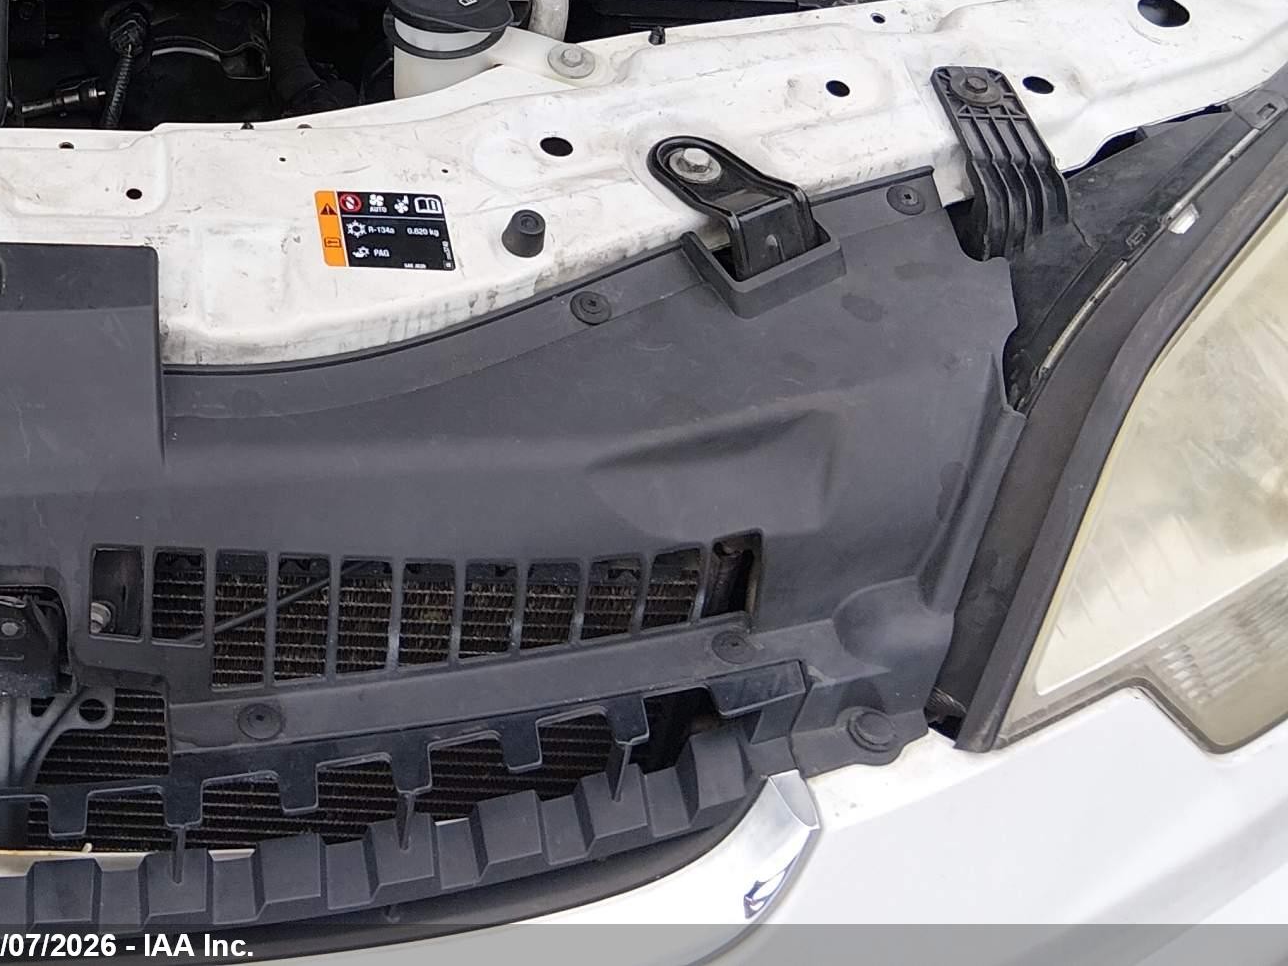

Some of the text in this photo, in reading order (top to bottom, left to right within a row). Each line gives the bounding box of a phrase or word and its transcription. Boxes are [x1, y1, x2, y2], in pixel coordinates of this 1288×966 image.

[368, 226, 395, 234] R-134a
[429, 228, 440, 237] kg
[373, 248, 390, 257] PAG
